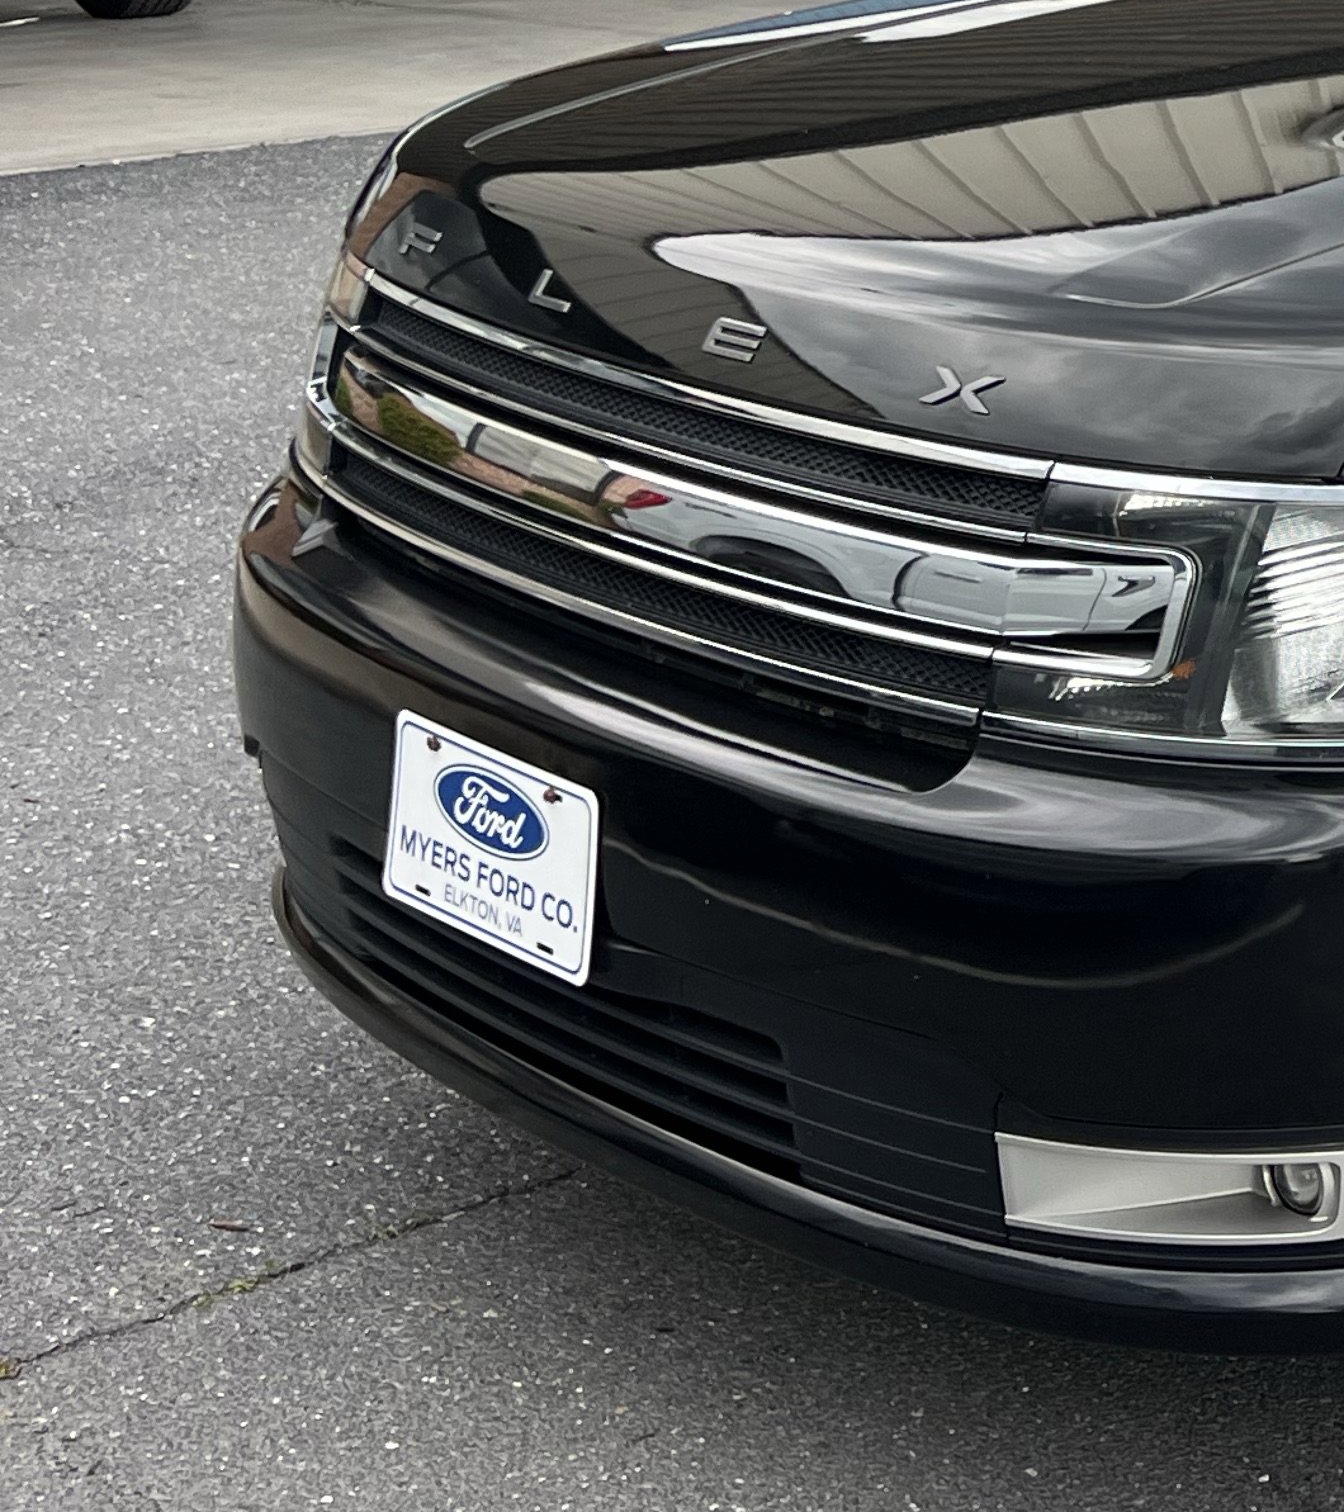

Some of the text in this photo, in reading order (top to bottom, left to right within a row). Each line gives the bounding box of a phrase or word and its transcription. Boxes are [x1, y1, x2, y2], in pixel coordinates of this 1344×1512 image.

[398, 221, 1007, 415] FLEX
[453, 775, 528, 849] Ford
[400, 824, 579, 934] MYERS FORD CO.
[506, 913, 524, 938] VA
